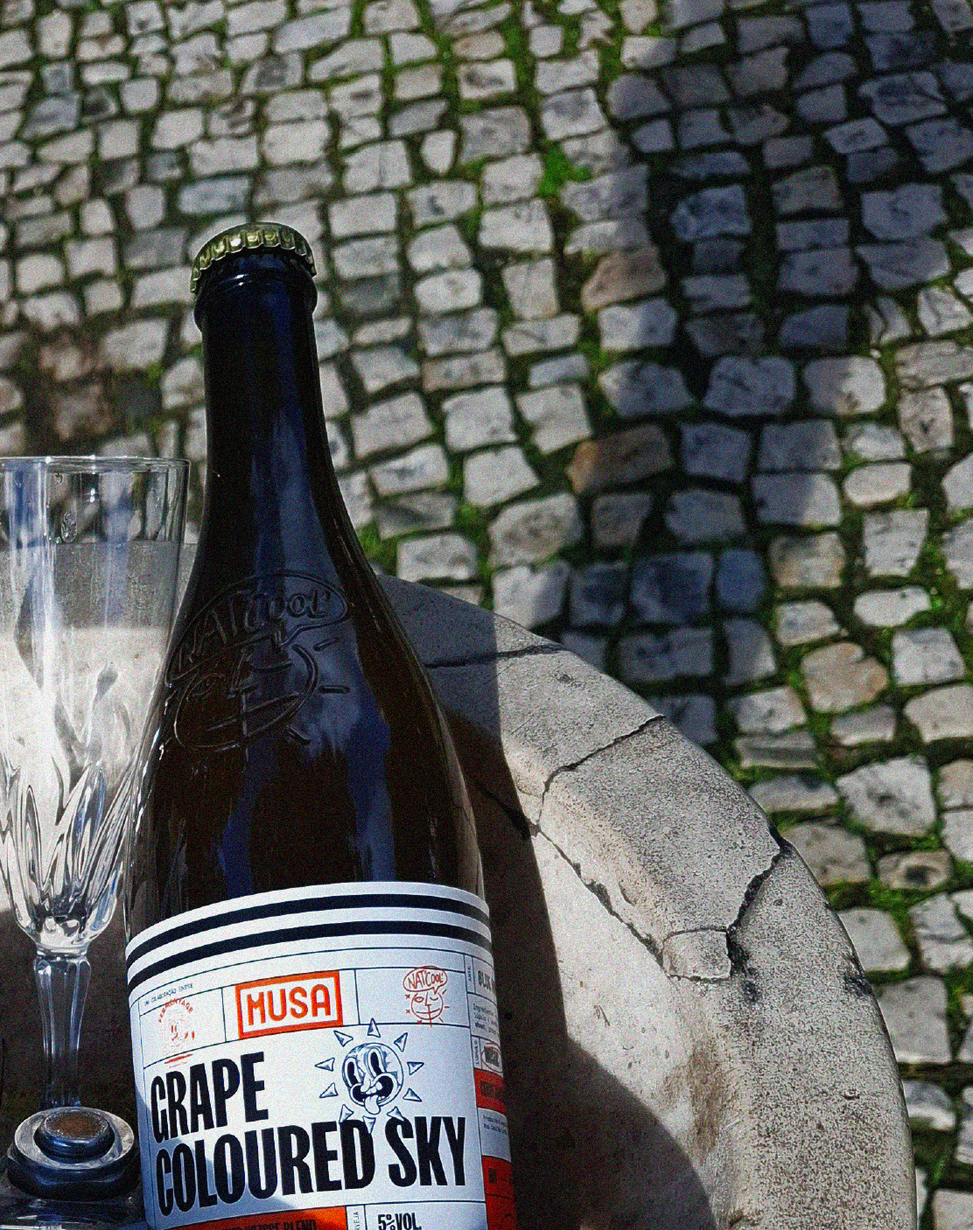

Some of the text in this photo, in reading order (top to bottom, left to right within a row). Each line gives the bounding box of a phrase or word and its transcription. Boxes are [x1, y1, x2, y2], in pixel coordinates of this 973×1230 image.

[247, 984, 331, 1026] MUSA
[150, 1051, 269, 1144] GRAPE
[156, 1115, 466, 1217] COLOURED SKY
